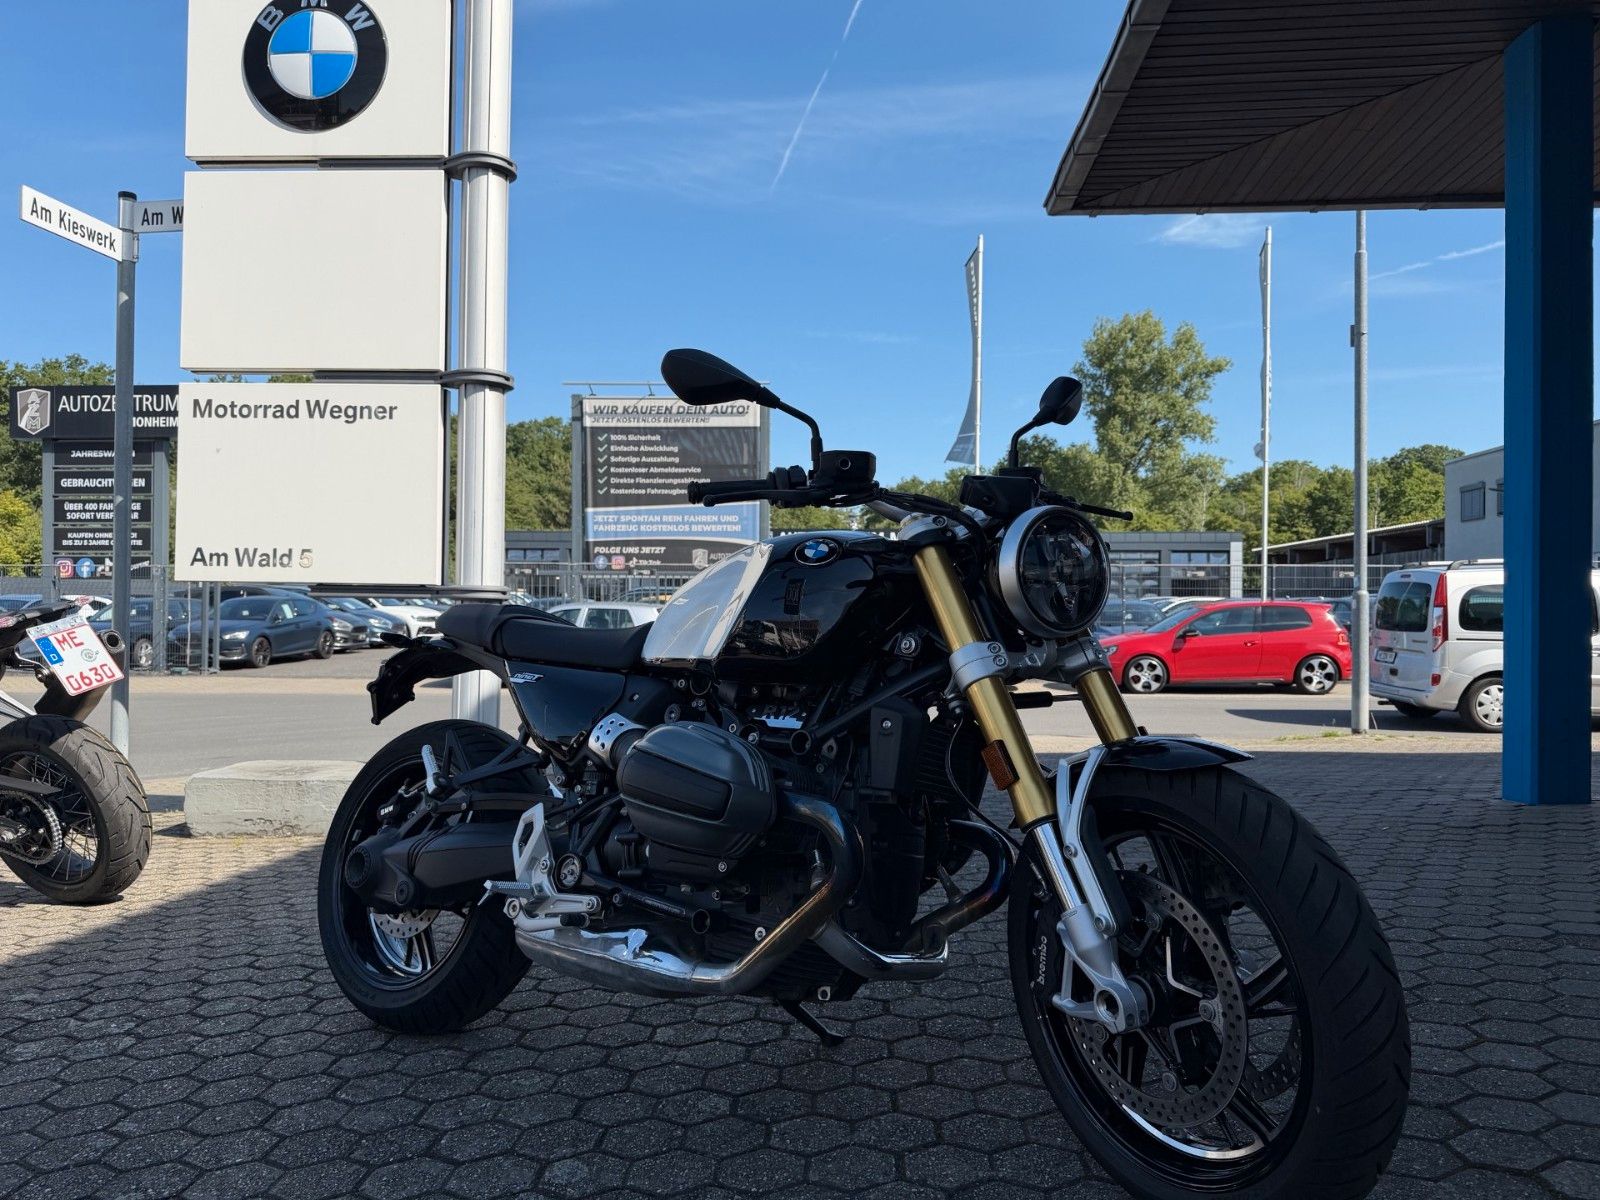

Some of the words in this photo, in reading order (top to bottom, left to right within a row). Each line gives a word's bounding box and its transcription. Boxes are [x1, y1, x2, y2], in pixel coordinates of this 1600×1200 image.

[30, 197, 52, 224] Am
[58, 209, 117, 253] Kieswerk
[141, 207, 164, 226] Am
[171, 205, 184, 224] W
[58, 395, 178, 412] AUTOZTRUM
[192, 398, 300, 419] Motorrad
[306, 399, 398, 424] Wegner
[593, 405, 619, 415] WIR
[622, 405, 674, 415] KAUFEN
[676, 405, 706, 415] DEIN
[710, 405, 750, 415] AUTO!
[640, 445, 678, 453] Abwicklung
[61, 478, 146, 487] GEBRAUCHTEN
[64, 501, 83, 510] ÜBER
[190, 547, 229, 567] Am
[235, 547, 293, 568] Wald
[299, 548, 314, 568] 5
[594, 546, 621, 554] FOLGE
[621, 546, 640, 554] UNS
[640, 546, 666, 554] JETZT
[54, 631, 84, 652] ME
[1037, 935, 1048, 986] brembo
